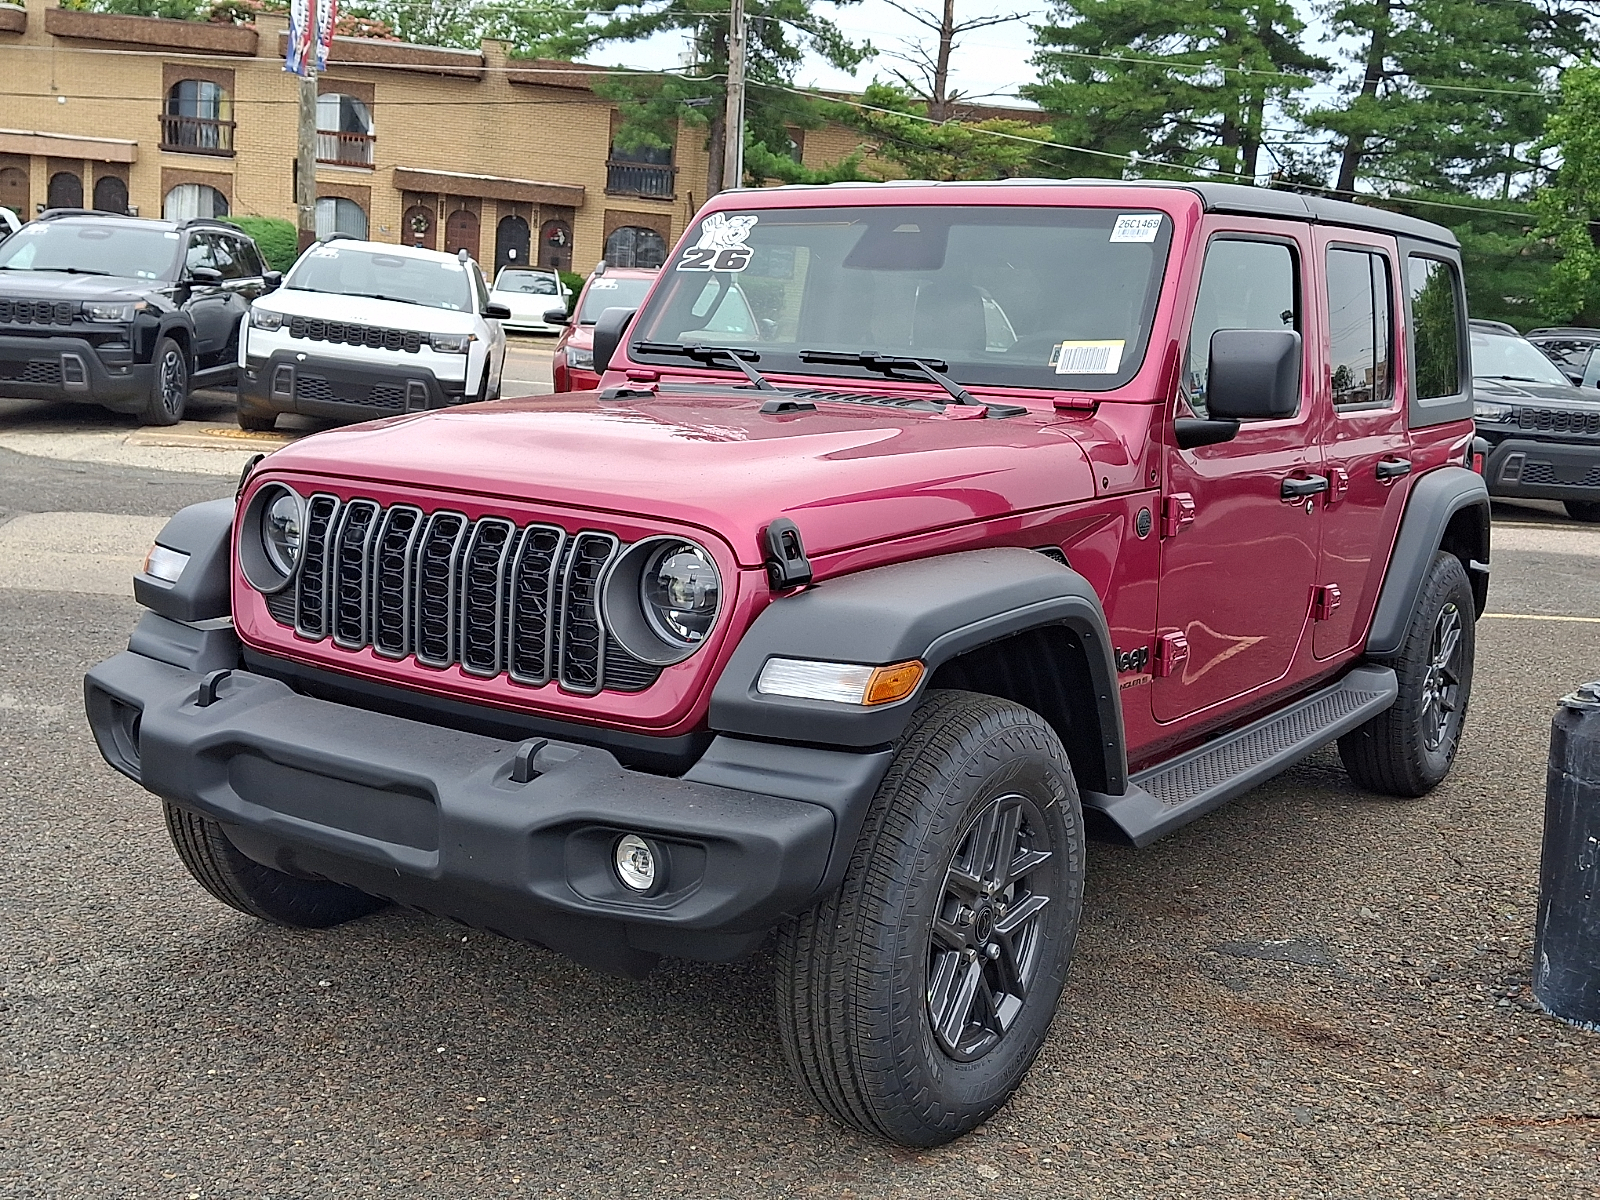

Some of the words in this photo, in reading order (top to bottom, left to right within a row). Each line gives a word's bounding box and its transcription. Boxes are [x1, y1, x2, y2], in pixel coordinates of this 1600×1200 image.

[1118, 219, 1160, 229] 26C1469
[679, 249, 751, 270] 26
[1114, 645, 1149, 673] Jeep
